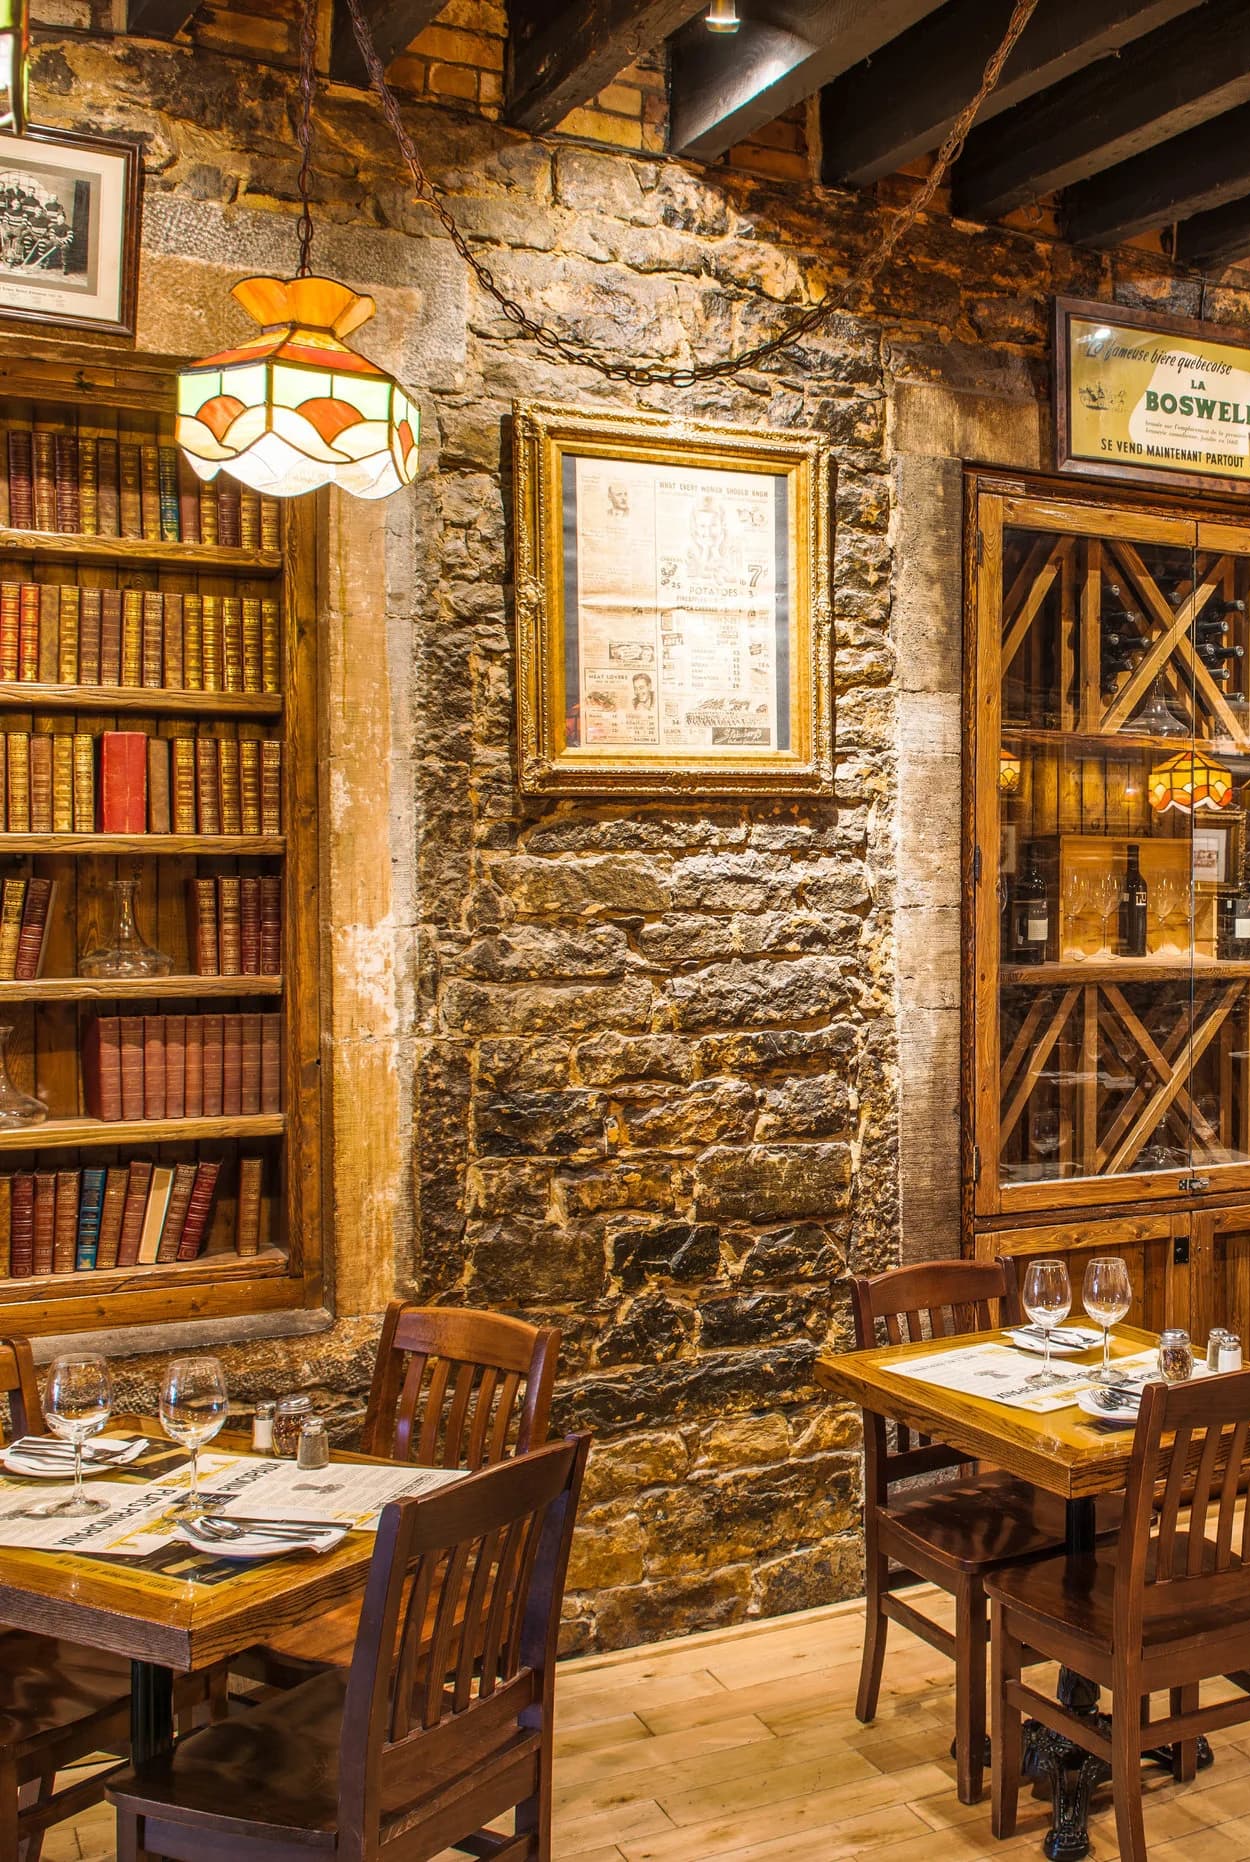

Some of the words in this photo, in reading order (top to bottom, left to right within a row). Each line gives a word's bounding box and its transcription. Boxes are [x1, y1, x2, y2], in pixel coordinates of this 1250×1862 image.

[1104, 341, 1150, 362] fameuse
[1190, 378, 1207, 391] LA
[1100, 437, 1113, 452] SE
[1116, 440, 1143, 455] VEND
[1146, 444, 1203, 463] MAINTENANT
[1205, 452, 1245, 469] PARTOUT
[689, 585, 738, 598] POTATOES
[128, 1488, 177, 1508] PLATS
[52, 1507, 142, 1547] PRINCIPAUX
